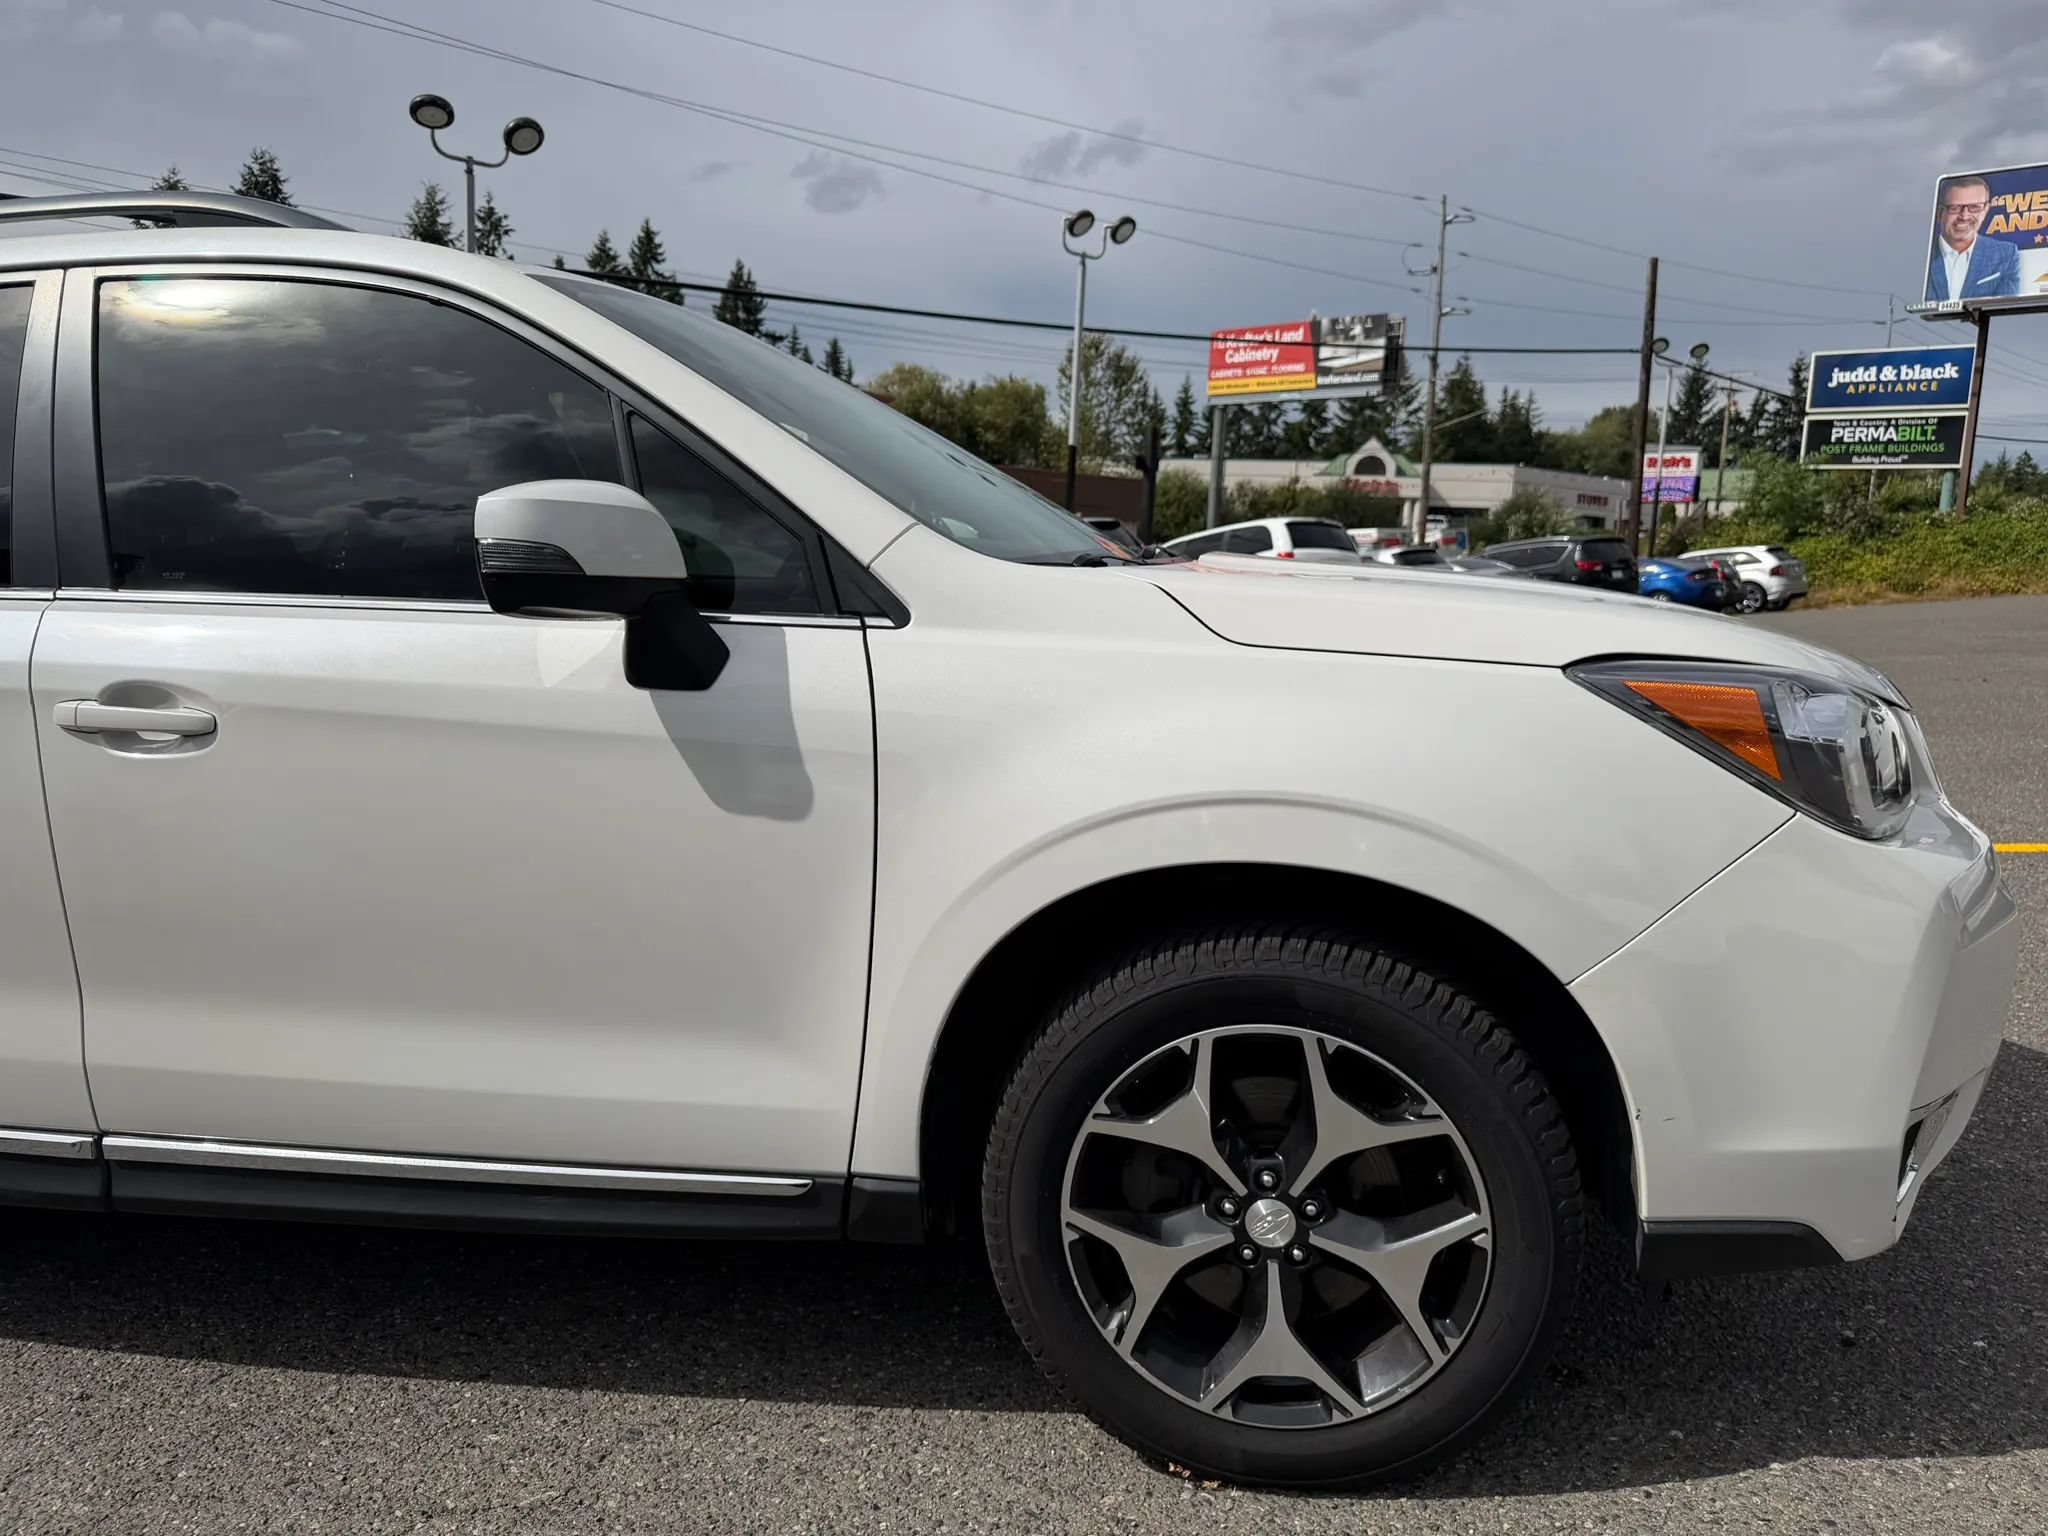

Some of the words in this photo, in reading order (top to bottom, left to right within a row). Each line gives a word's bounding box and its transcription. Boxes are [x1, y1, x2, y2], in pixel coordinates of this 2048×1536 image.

[1986, 210, 2048, 235] AND
[1276, 326, 1304, 342] Land
[1225, 348, 1279, 364] Cabinetry
[1828, 365, 1877, 388] judd
[1879, 365, 1897, 381] &
[1900, 362, 1959, 381] black
[1846, 381, 1938, 394] APPLIANCE
[1820, 444, 1847, 455] POST
[1849, 443, 1885, 454] FRAME
[1887, 442, 1945, 453] BUILDINGS
[1647, 456, 1691, 469] Rch's
